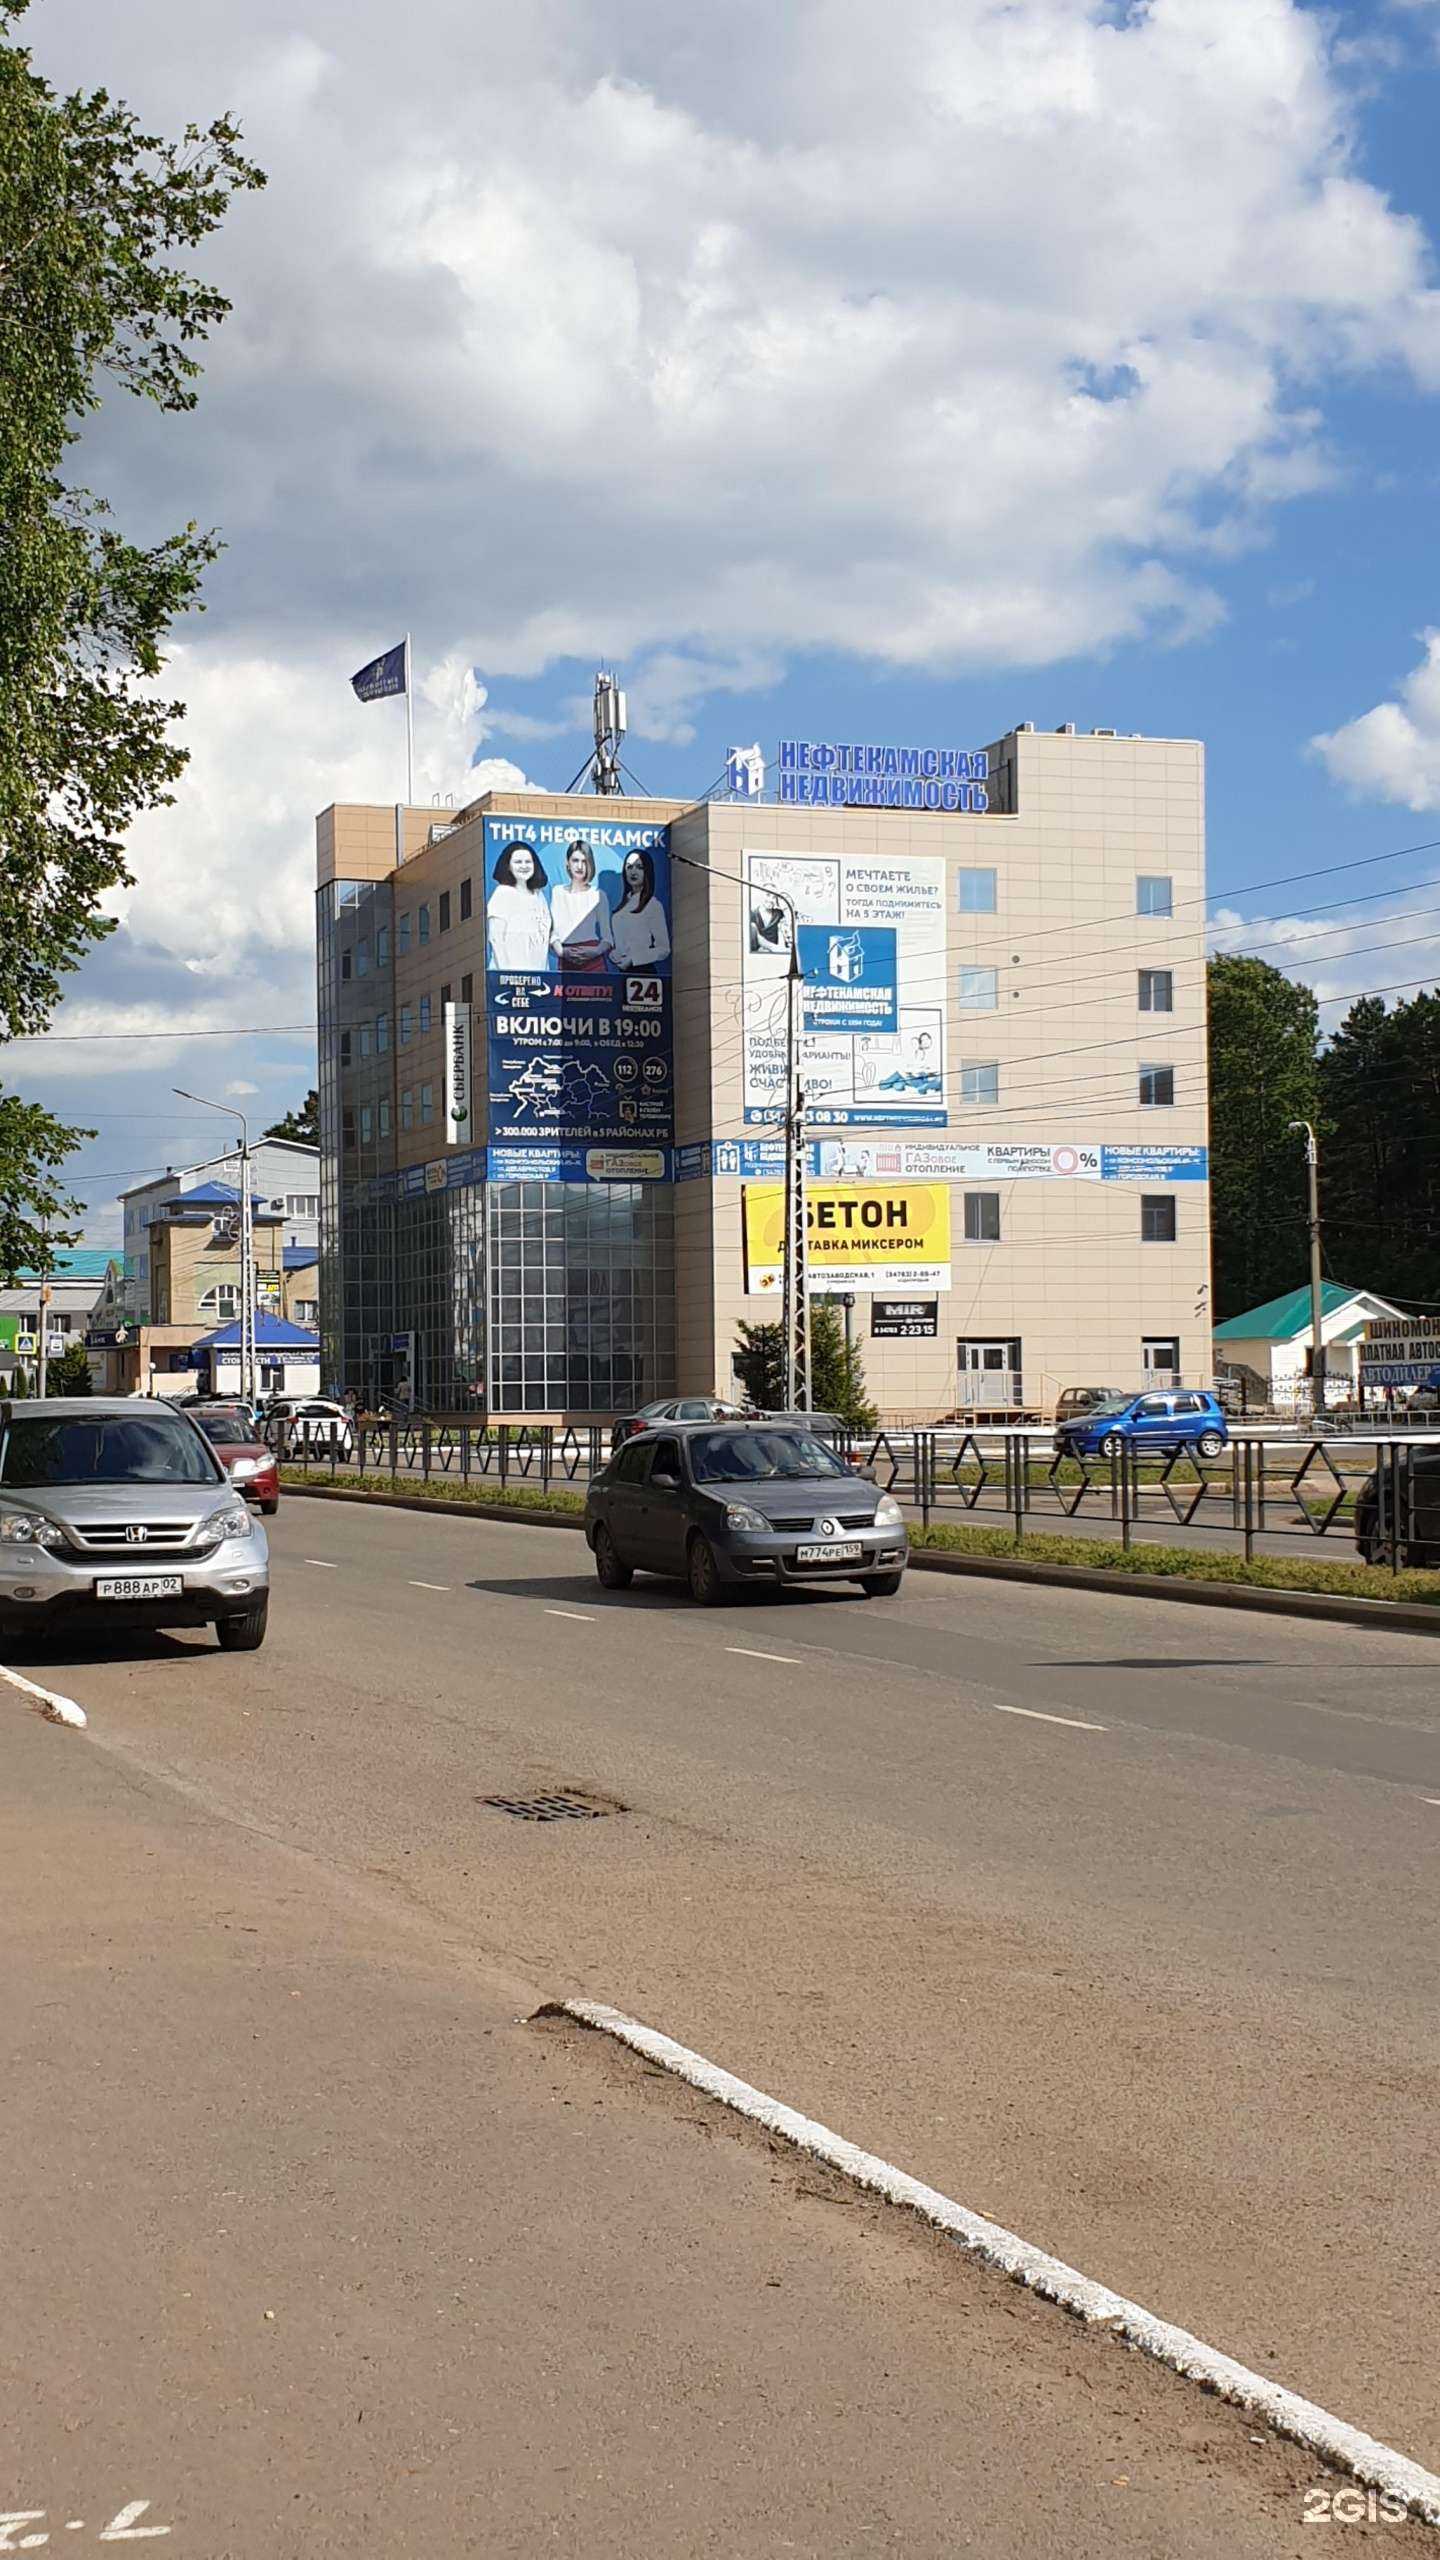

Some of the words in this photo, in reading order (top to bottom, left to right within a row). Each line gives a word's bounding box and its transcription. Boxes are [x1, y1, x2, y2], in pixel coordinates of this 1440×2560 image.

[779, 740, 989, 780] НЕФТЕКАМСКАЯ
[779, 771, 989, 811] НЕДВИЖИМОСТЬ
[489, 822, 536, 842] ТНТ4
[540, 826, 666, 848] НЕФТЕКАМСК
[846, 869, 911, 882] МЕЧТАЕТЕ
[846, 884, 853, 892] О
[857, 885, 893, 893] СВОЕМ
[896, 886, 939, 895] ЖИЛЬЕ?
[846, 899, 874, 907] ТОГДА
[876, 900, 942, 909] ПОДНИМИТЕСЬ
[846, 910, 860, 919] НА
[873, 911, 905, 919] ЭТАЖ!
[630, 981, 660, 1002] 24
[496, 1016, 593, 1036] ВКЛЮЧИ
[599, 1018, 610, 1036] В
[615, 1019, 662, 1037] 19:00
[512, 1038, 543, 1046] УТРОМ
[453, 1024, 465, 1101] СБЕРБАНК
[618, 1065, 632, 1075] 112
[645, 1065, 663, 1076] 276
[538, 1126, 592, 1137] ЗРИТЕЛЕЙ
[606, 1126, 655, 1137] РАЙОНАХ
[656, 1128, 669, 1137] РБ
[493, 1148, 527, 1158] НОВЫЕ
[987, 1146, 1051, 1157] КВАРТИРЫ
[1105, 1147, 1142, 1156] НОВЫЕ
[905, 1164, 967, 1174] ОТОПЛЕНИЕ
[778, 1239, 849, 1254] ДТАВКА
[852, 1237, 924, 1250] МИКСЕРОМ
[885, 1304, 927, 1316] MIR
[1360, 1343, 1405, 1361] ПЛАТНАЯ
[103, 1580, 160, 1595] Р888АР
[162, 1578, 177, 1589] 02
